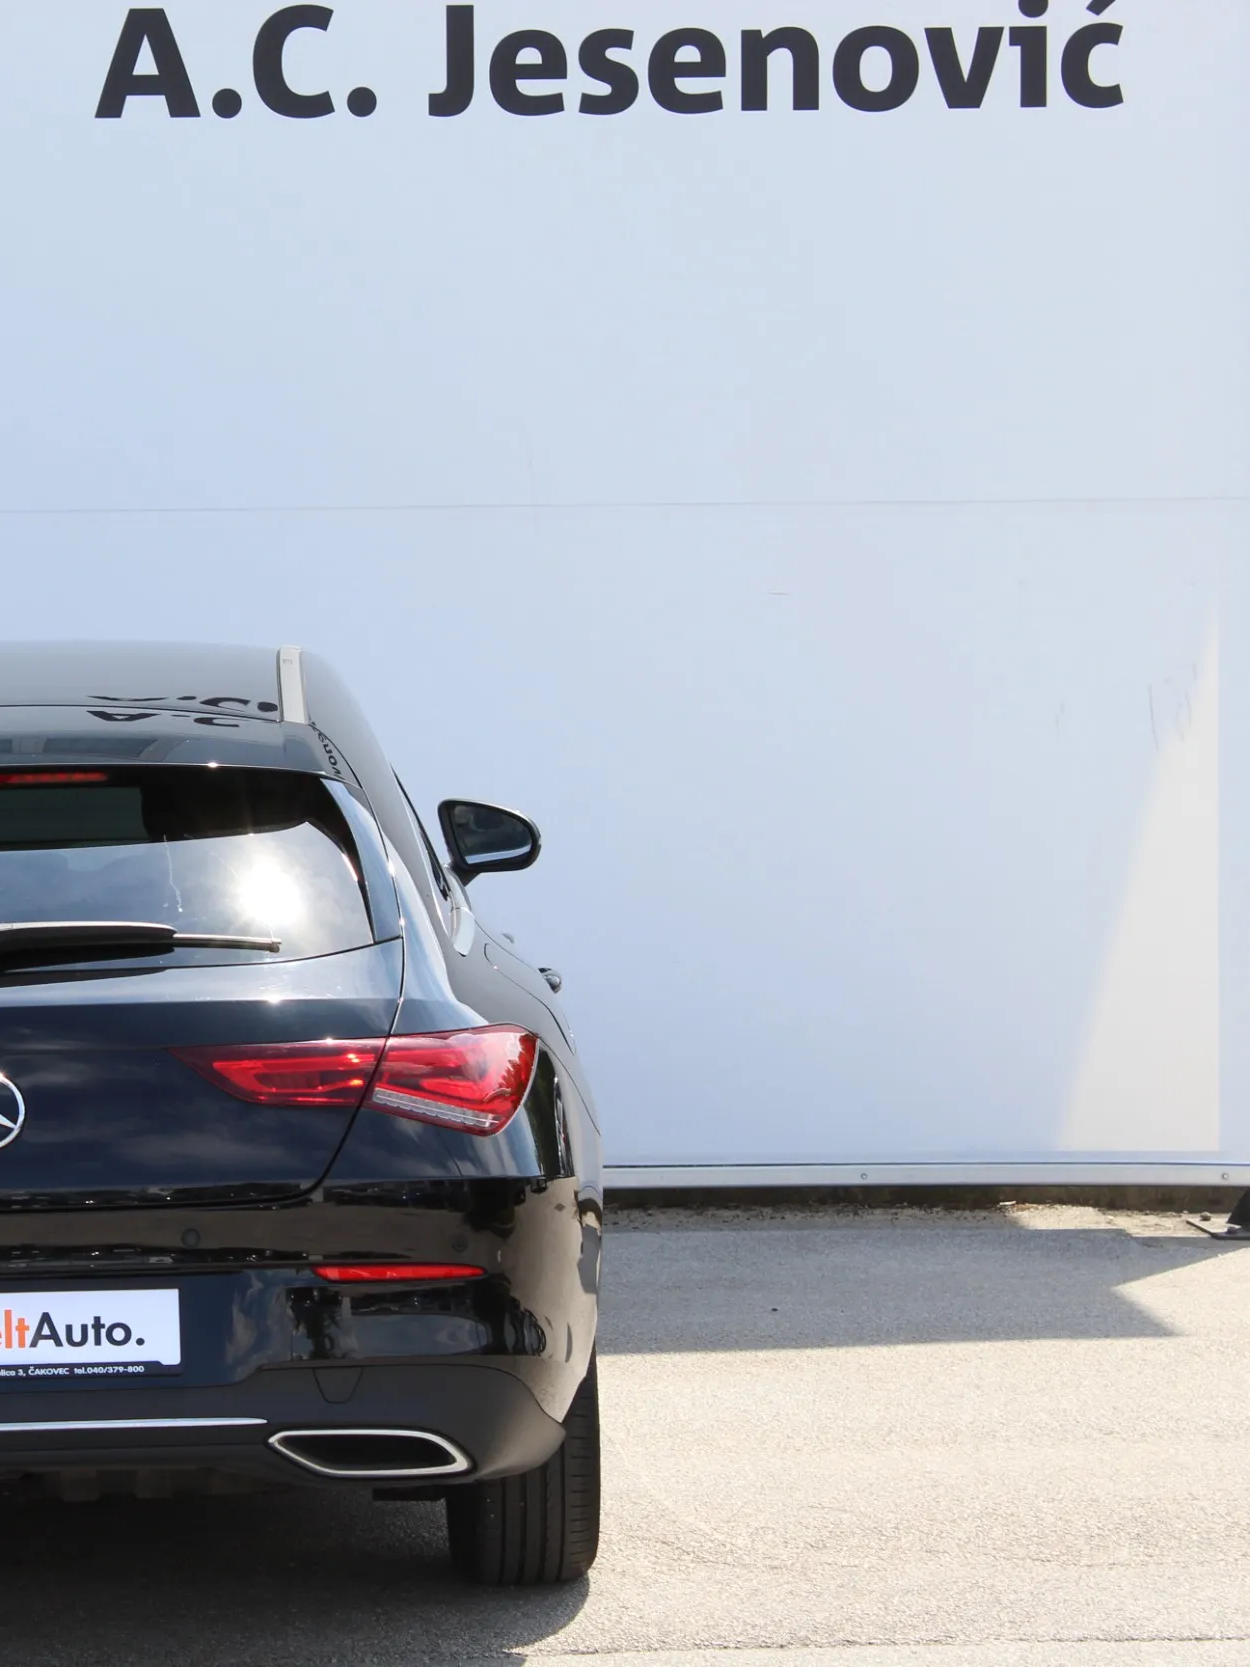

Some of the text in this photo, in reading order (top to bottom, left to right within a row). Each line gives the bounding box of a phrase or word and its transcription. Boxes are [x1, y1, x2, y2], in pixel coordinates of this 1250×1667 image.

[95, 0, 1124, 119] A.C. Jesenović
[17, 1368, 27, 1378] 3,
[28, 1366, 70, 1376] ČAKOVEC
